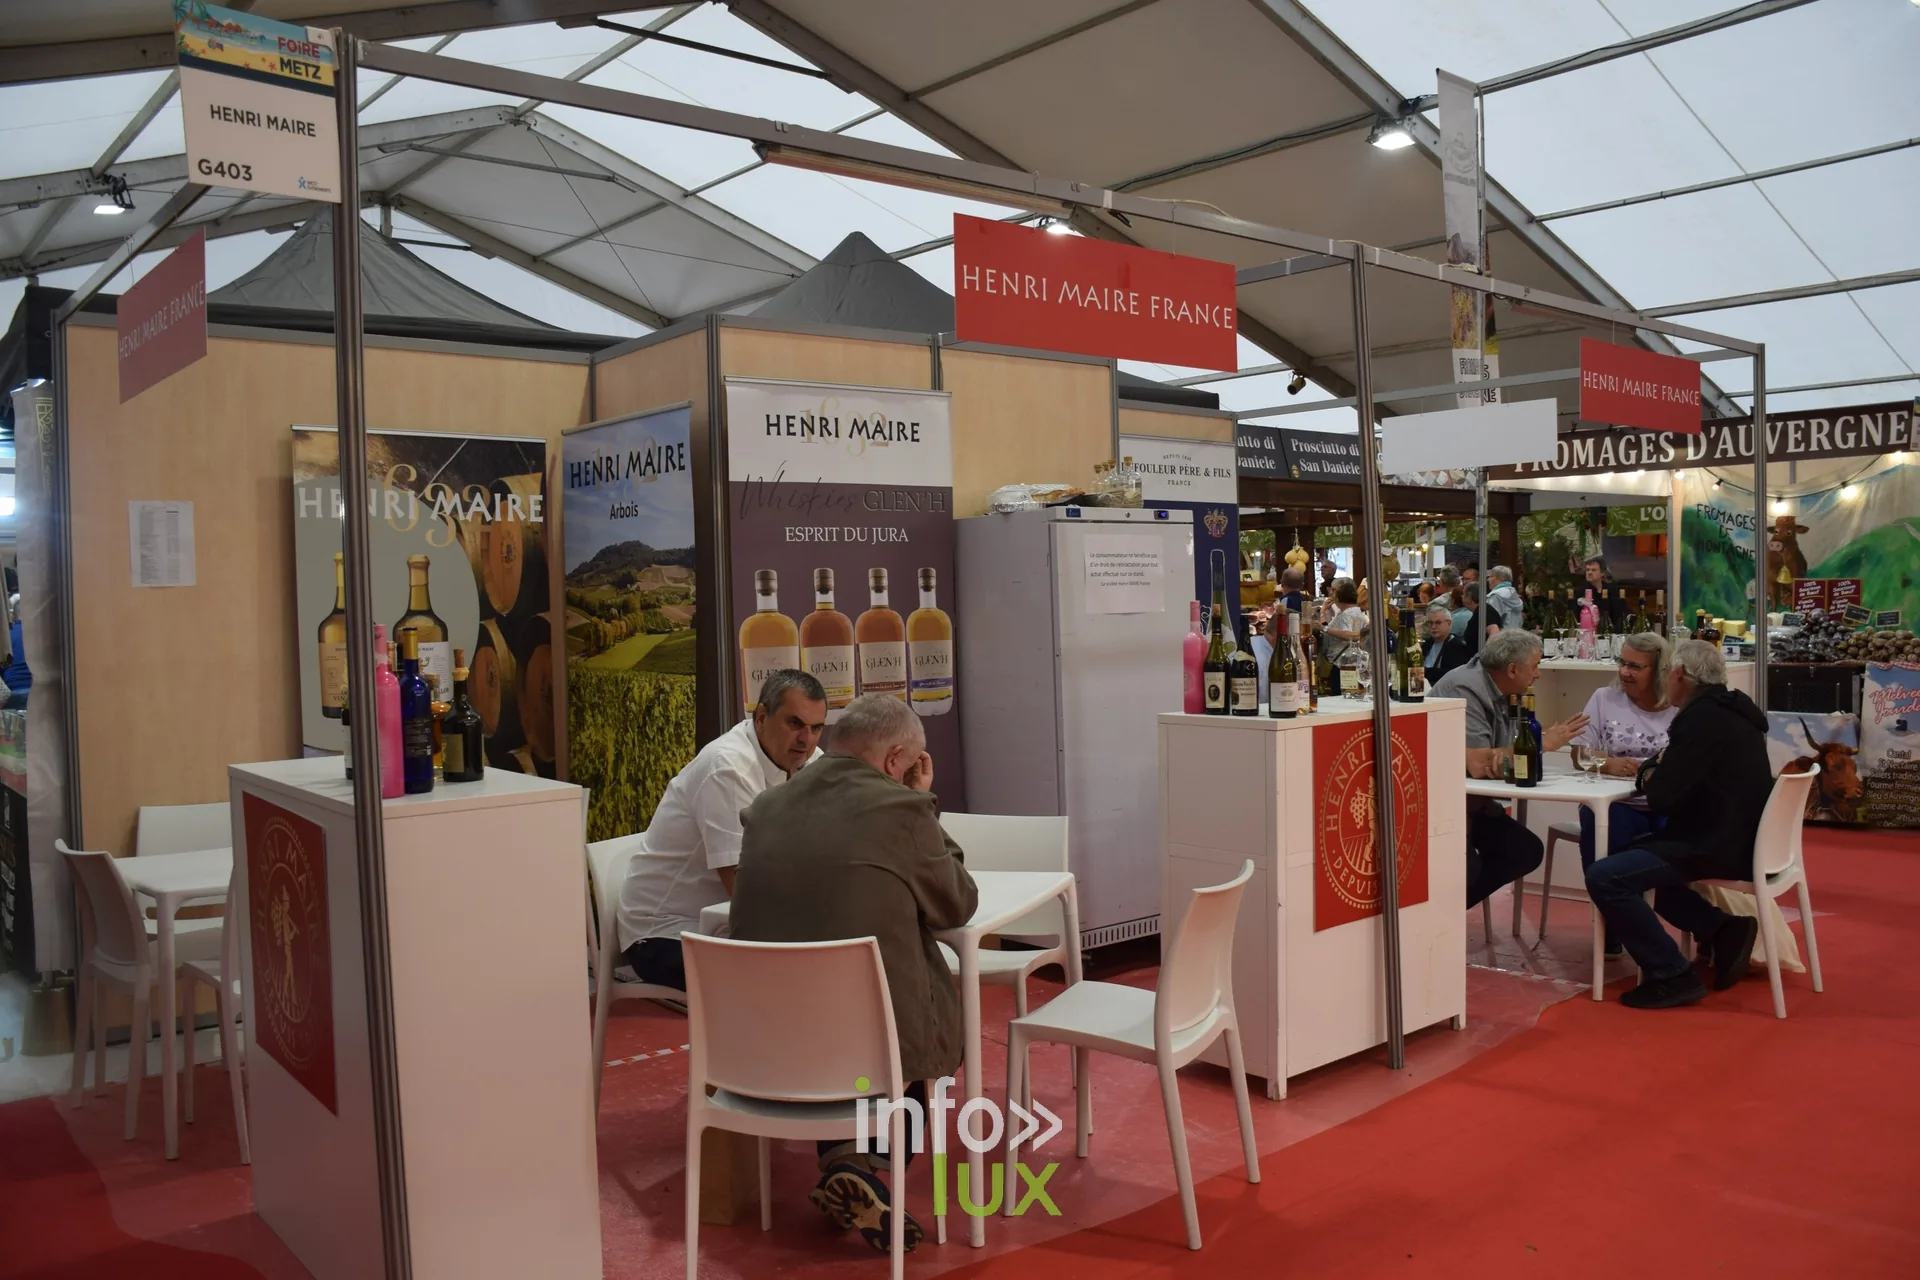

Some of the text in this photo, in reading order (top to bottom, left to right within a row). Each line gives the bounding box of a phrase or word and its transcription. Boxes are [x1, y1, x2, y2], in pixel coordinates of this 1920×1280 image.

[280, 57, 322, 80] METZ
[210, 104, 316, 138] HENRI MAIRE
[198, 158, 252, 182] G403
[962, 264, 1232, 330] HENRI MAIRE FRANCE
[119, 280, 204, 360] HENRI MAIRE FRANCE
[1583, 370, 1700, 407] HENRI MAIRE FRANCE
[766, 414, 920, 442] HENRI MAIRE
[1264, 436, 1275, 450] di
[1291, 438, 1360, 456] Prosciutto di
[570, 442, 686, 489] HENRI MAIRE
[1180, 464, 1201, 476] PÈRE
[1204, 469, 1210, 477] &
[1213, 468, 1231, 478] FILS
[1300, 458, 1361, 475] San Daniele
[739, 460, 853, 520] Whiskies
[430, 490, 544, 523] MAIRE
[610, 501, 639, 520] Arbois
[1697, 504, 1756, 532] FROMAGES
[785, 527, 909, 545] ESPRIT DU JURA
[1886, 748, 1912, 760] Cantal
[1886, 759, 1918, 770] Nectaire
[1325, 741, 1418, 832] HENRI AIRE
[1867, 780, 1894, 789] Fourme
[1867, 790, 1882, 800] Bleu
